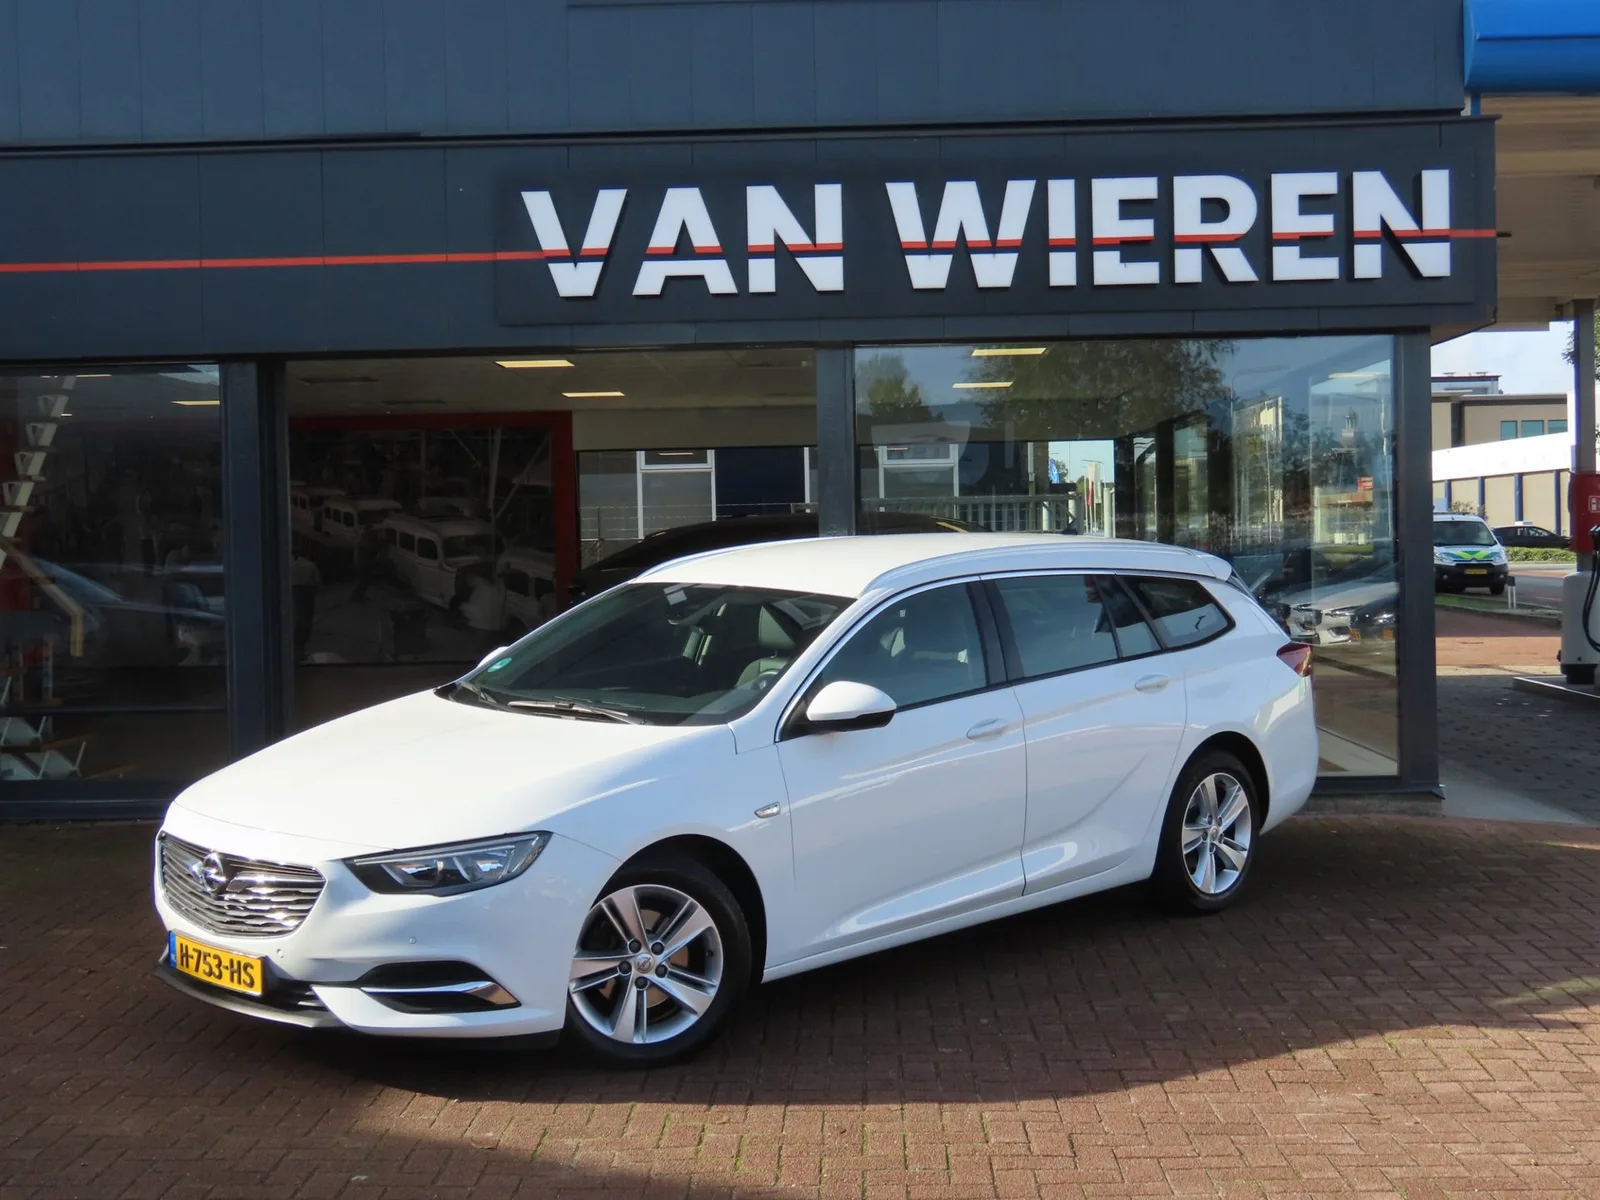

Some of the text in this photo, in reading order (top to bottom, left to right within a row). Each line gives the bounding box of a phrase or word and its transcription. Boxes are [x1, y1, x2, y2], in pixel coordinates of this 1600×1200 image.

[520, 168, 1451, 297] VAN WIEREN
[179, 942, 255, 989] H-753-HS
